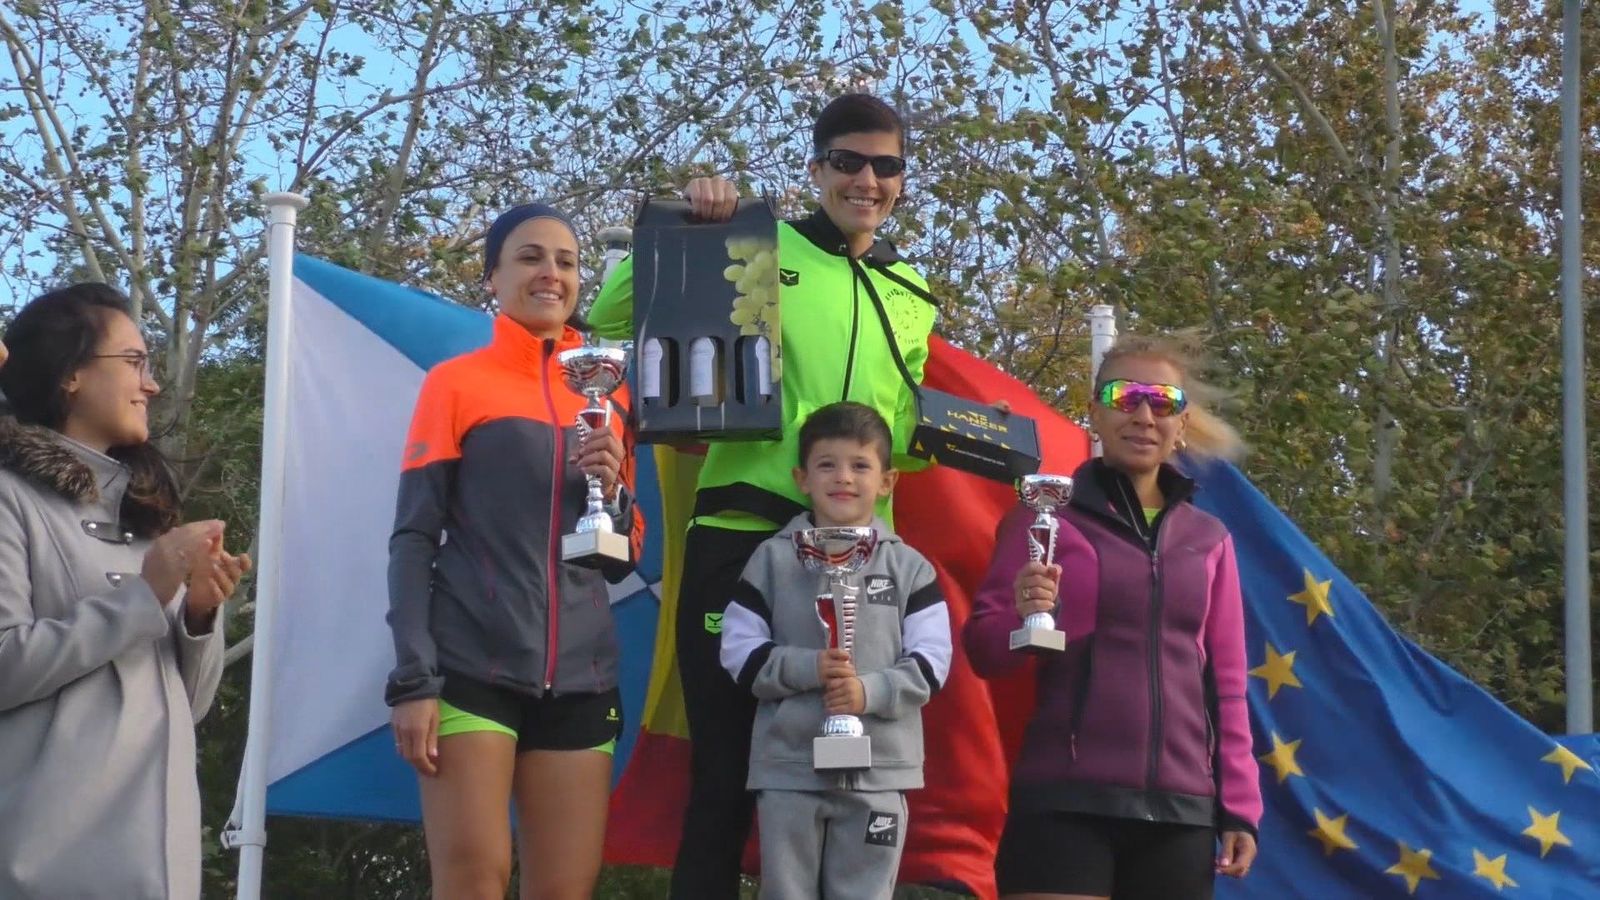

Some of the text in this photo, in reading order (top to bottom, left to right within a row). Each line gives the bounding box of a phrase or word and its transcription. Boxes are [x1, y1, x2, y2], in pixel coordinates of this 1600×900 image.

[947, 410, 1008, 432] HANKER
[870, 578, 891, 588] NIKE
[874, 816, 893, 827] NIKE
